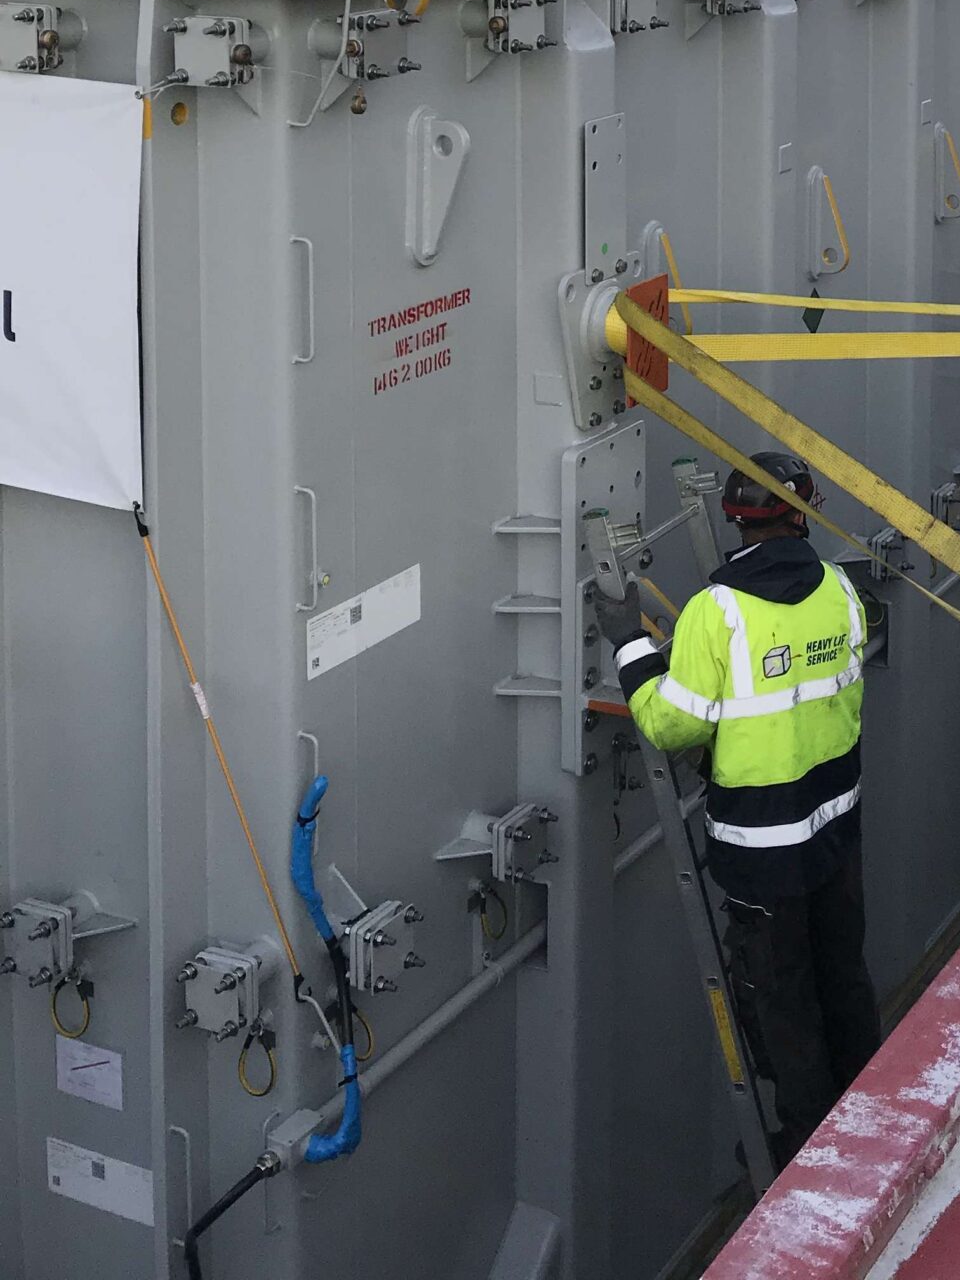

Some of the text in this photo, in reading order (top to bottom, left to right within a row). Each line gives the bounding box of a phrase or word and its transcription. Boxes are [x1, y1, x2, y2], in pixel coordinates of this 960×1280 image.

[367, 287, 471, 337] TRANSFORMER
[395, 322, 448, 358] WEIGHT
[806, 633, 848, 654] HEAVY LIF
[806, 648, 838, 667] SERVICE
